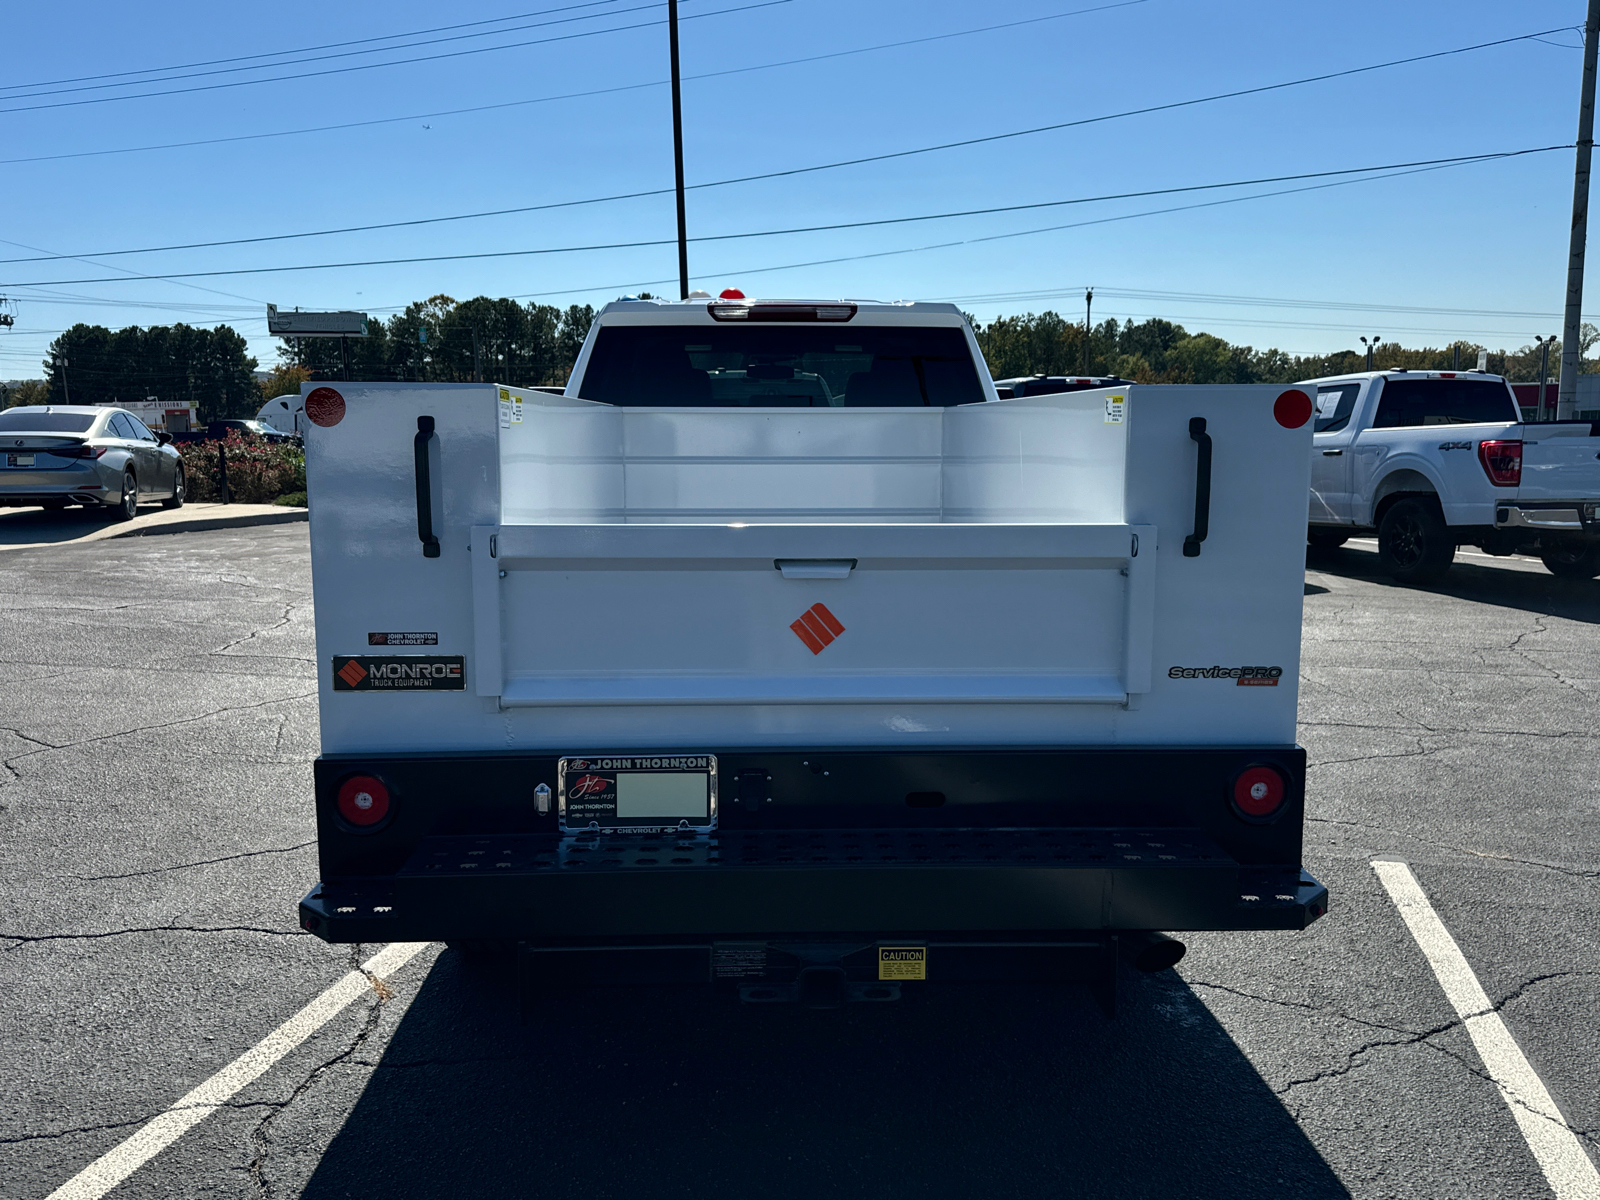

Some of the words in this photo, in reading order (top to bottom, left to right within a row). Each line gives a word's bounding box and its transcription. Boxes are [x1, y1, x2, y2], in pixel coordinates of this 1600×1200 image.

[370, 664, 461, 678] MONROE
[370, 678, 393, 687] TRUCK
[394, 678, 433, 687] EQUIPMENT
[596, 759, 632, 769] JOHN
[882, 951, 923, 960] CAUTION
